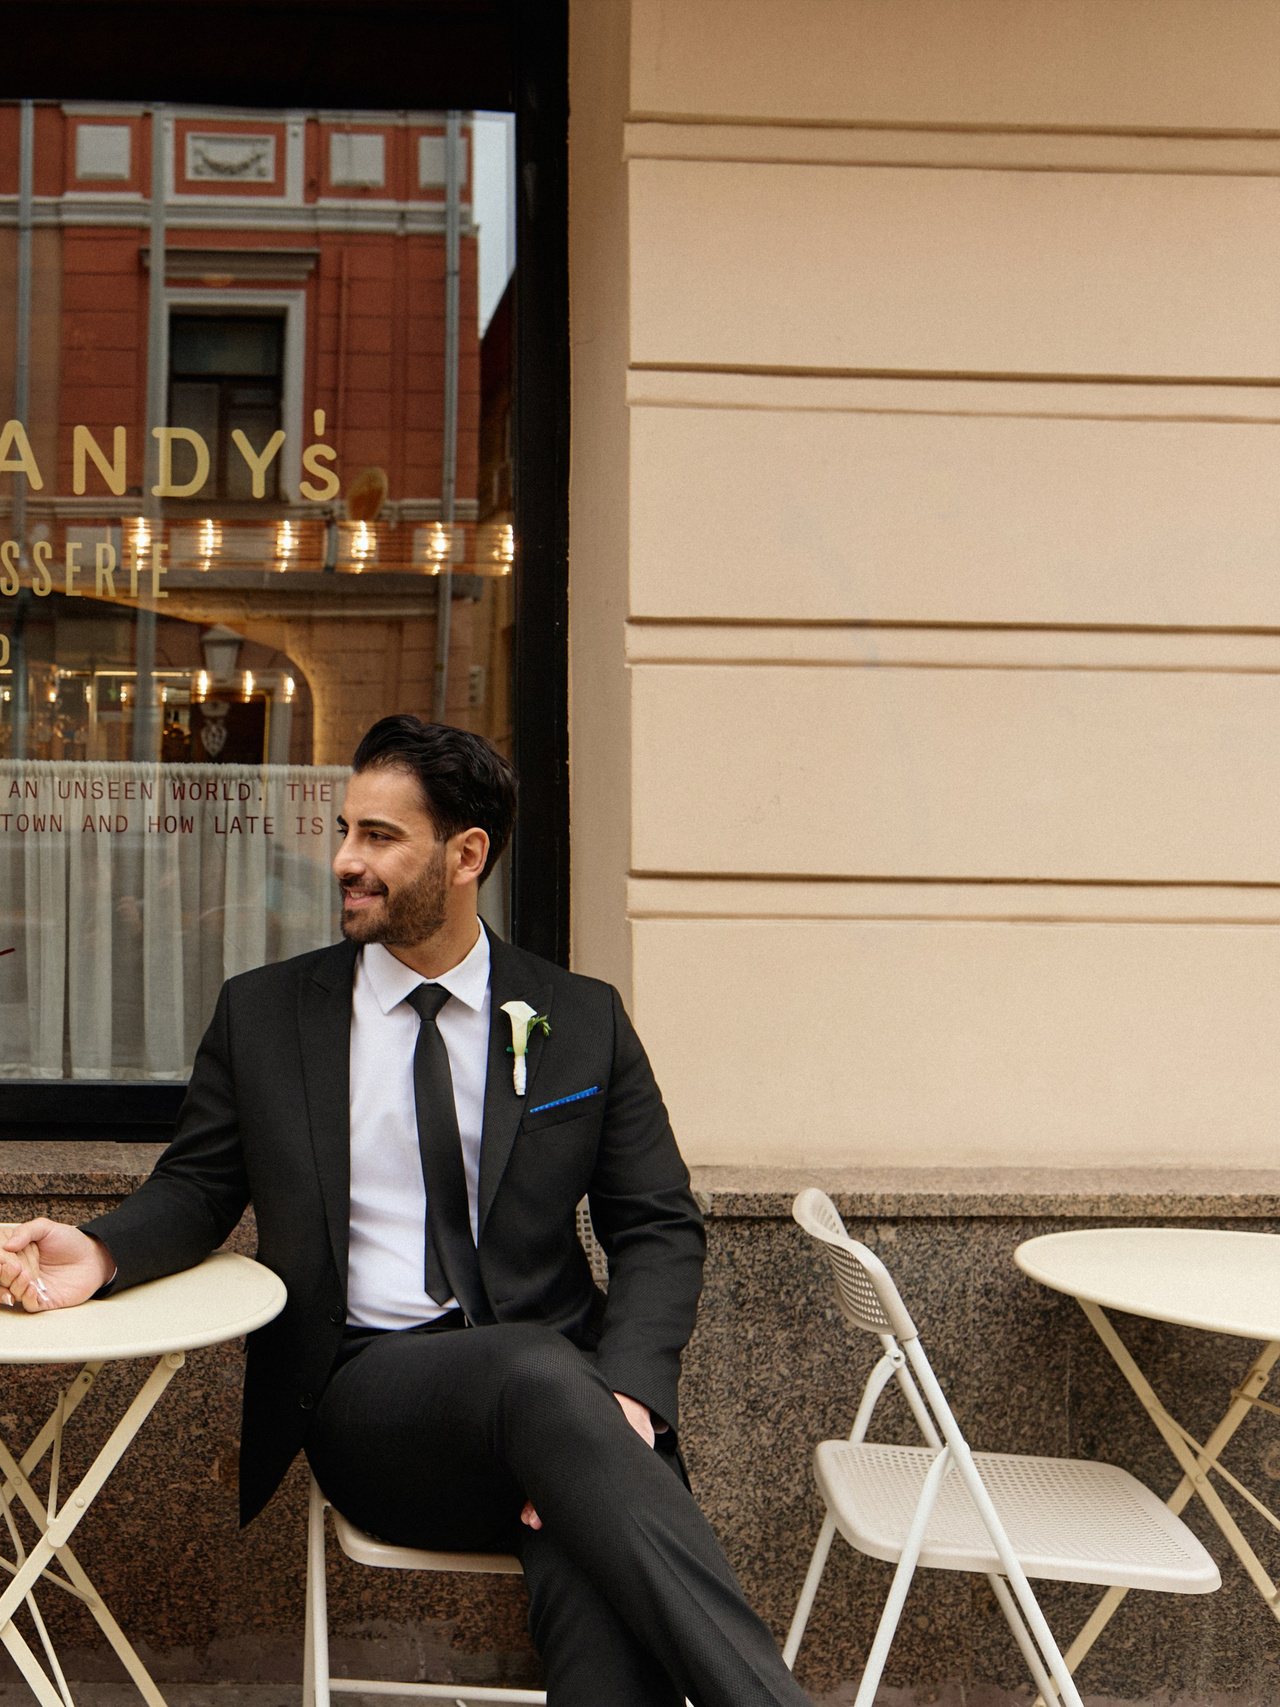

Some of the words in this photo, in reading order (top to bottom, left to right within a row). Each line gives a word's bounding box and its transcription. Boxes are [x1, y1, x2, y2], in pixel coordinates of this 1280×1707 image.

[8, 780, 39, 799] AN
[58, 780, 153, 800] UNSEEN
[172, 782, 264, 802] WORLD.
[286, 784, 331, 802] THE
[82, 815, 129, 833] AND
[148, 815, 195, 834] HOW
[214, 816, 275, 835] LATE
[296, 816, 324, 835] IS
